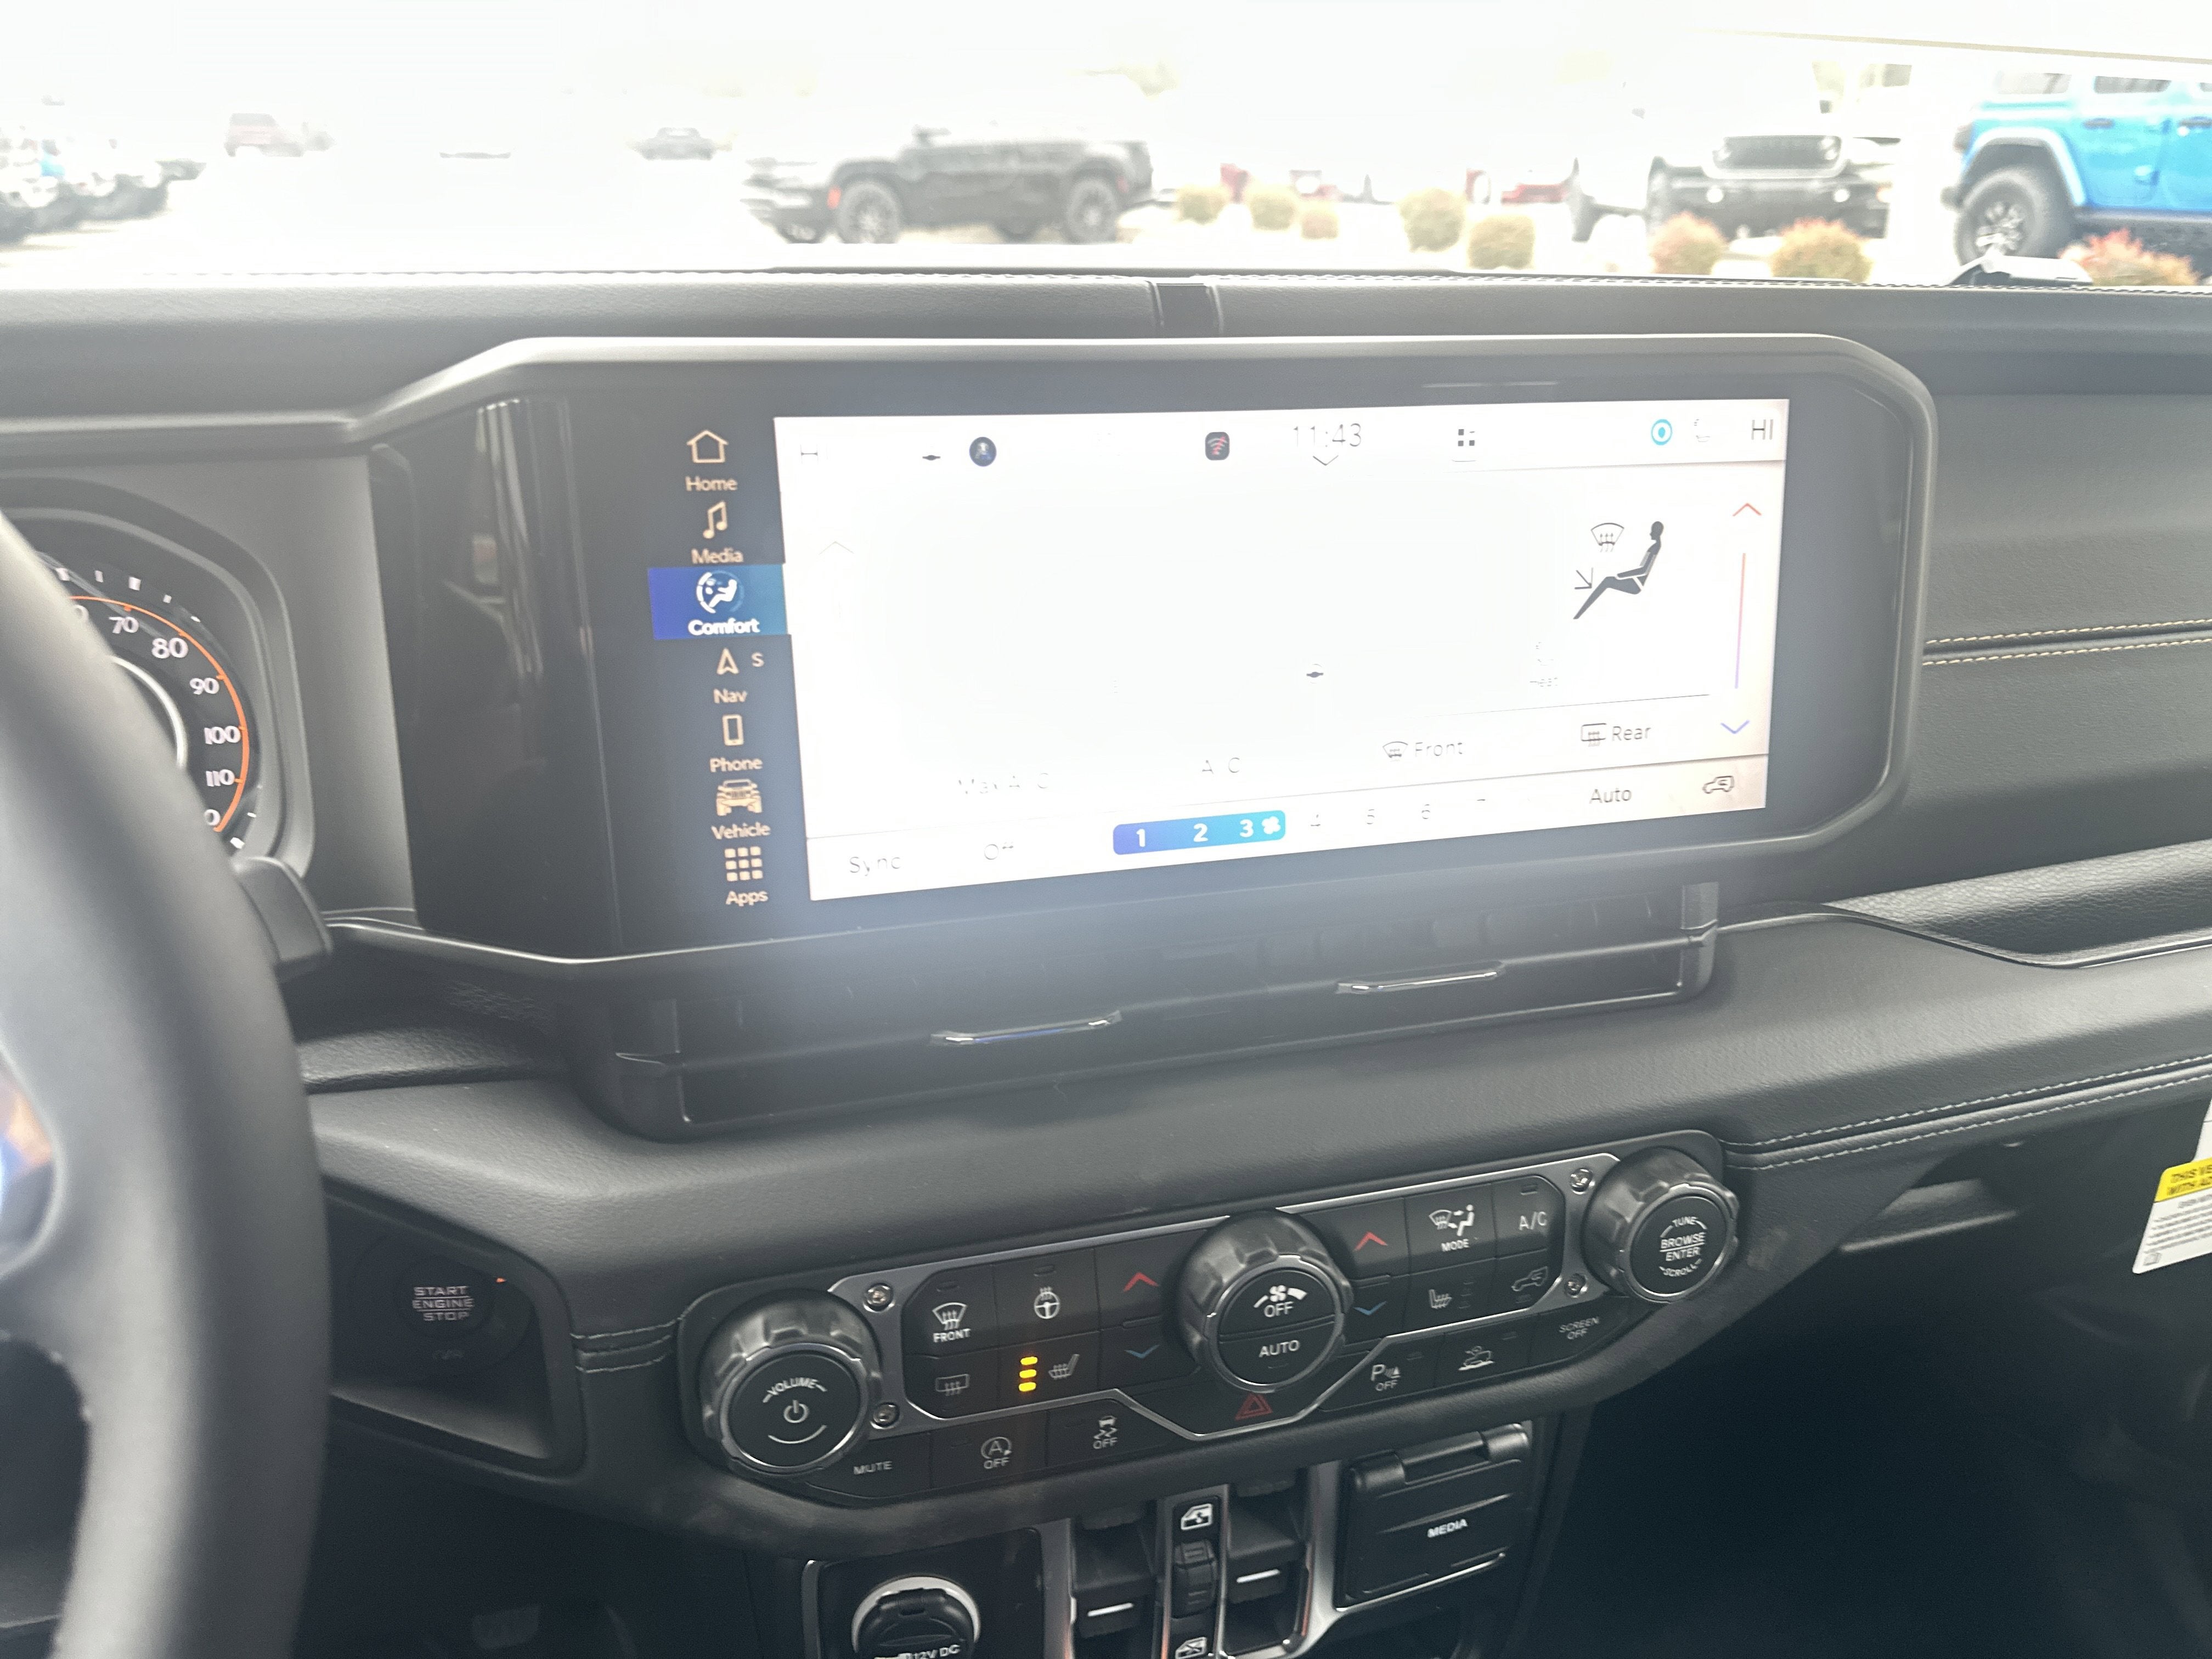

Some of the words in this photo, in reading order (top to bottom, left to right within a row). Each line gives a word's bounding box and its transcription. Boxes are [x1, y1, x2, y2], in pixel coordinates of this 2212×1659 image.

[1293, 422, 1362, 448] 11:43
[1751, 419, 1774, 441] HI
[685, 476, 738, 492] Home
[691, 548, 743, 565] Media
[109, 616, 139, 634] 70
[687, 617, 760, 636] Comfort
[151, 637, 189, 659] 80
[752, 652, 765, 668] S
[189, 678, 220, 695] 90
[713, 689, 748, 703] Nav
[204, 725, 241, 744] 100
[1612, 724, 1652, 741] Rear
[1415, 738, 1463, 757] Front
[710, 757, 763, 772] Phone
[205, 769, 235, 787] 110
[1589, 787, 1632, 804] Auto
[712, 823, 771, 839] Vehicle
[1136, 828, 1146, 848] 1
[1193, 823, 1209, 842] 2
[1239, 819, 1255, 838] 3
[849, 855, 901, 876] Sync
[726, 890, 768, 906] Apps
[1519, 1211, 1547, 1231] A/C
[1672, 1216, 1699, 1227] TUNE
[1441, 1238, 1470, 1252] MODE
[1661, 1232, 1706, 1249] BROWSE
[1666, 1246, 1701, 1261] ENTER
[1663, 1263, 1698, 1277] SCROLL
[414, 1286, 469, 1296] START
[412, 1299, 475, 1309] ENGINE
[1264, 1301, 1294, 1317] OFF
[423, 1312, 469, 1322] STOP
[1559, 1317, 1600, 1333] SCREEN
[933, 1328, 971, 1343] FRONT
[1567, 1328, 1588, 1339] OFF
[1259, 1340, 1300, 1358] AUTO
[767, 1377, 819, 1395] VOLUME
[1375, 1379, 1398, 1391] OFF
[1093, 1437, 1118, 1449] OFF
[853, 1460, 893, 1475] MUTE
[984, 1457, 1010, 1469] OFF
[1427, 1519, 1468, 1538] MEDIA
[939, 1644, 960, 1657] DC
